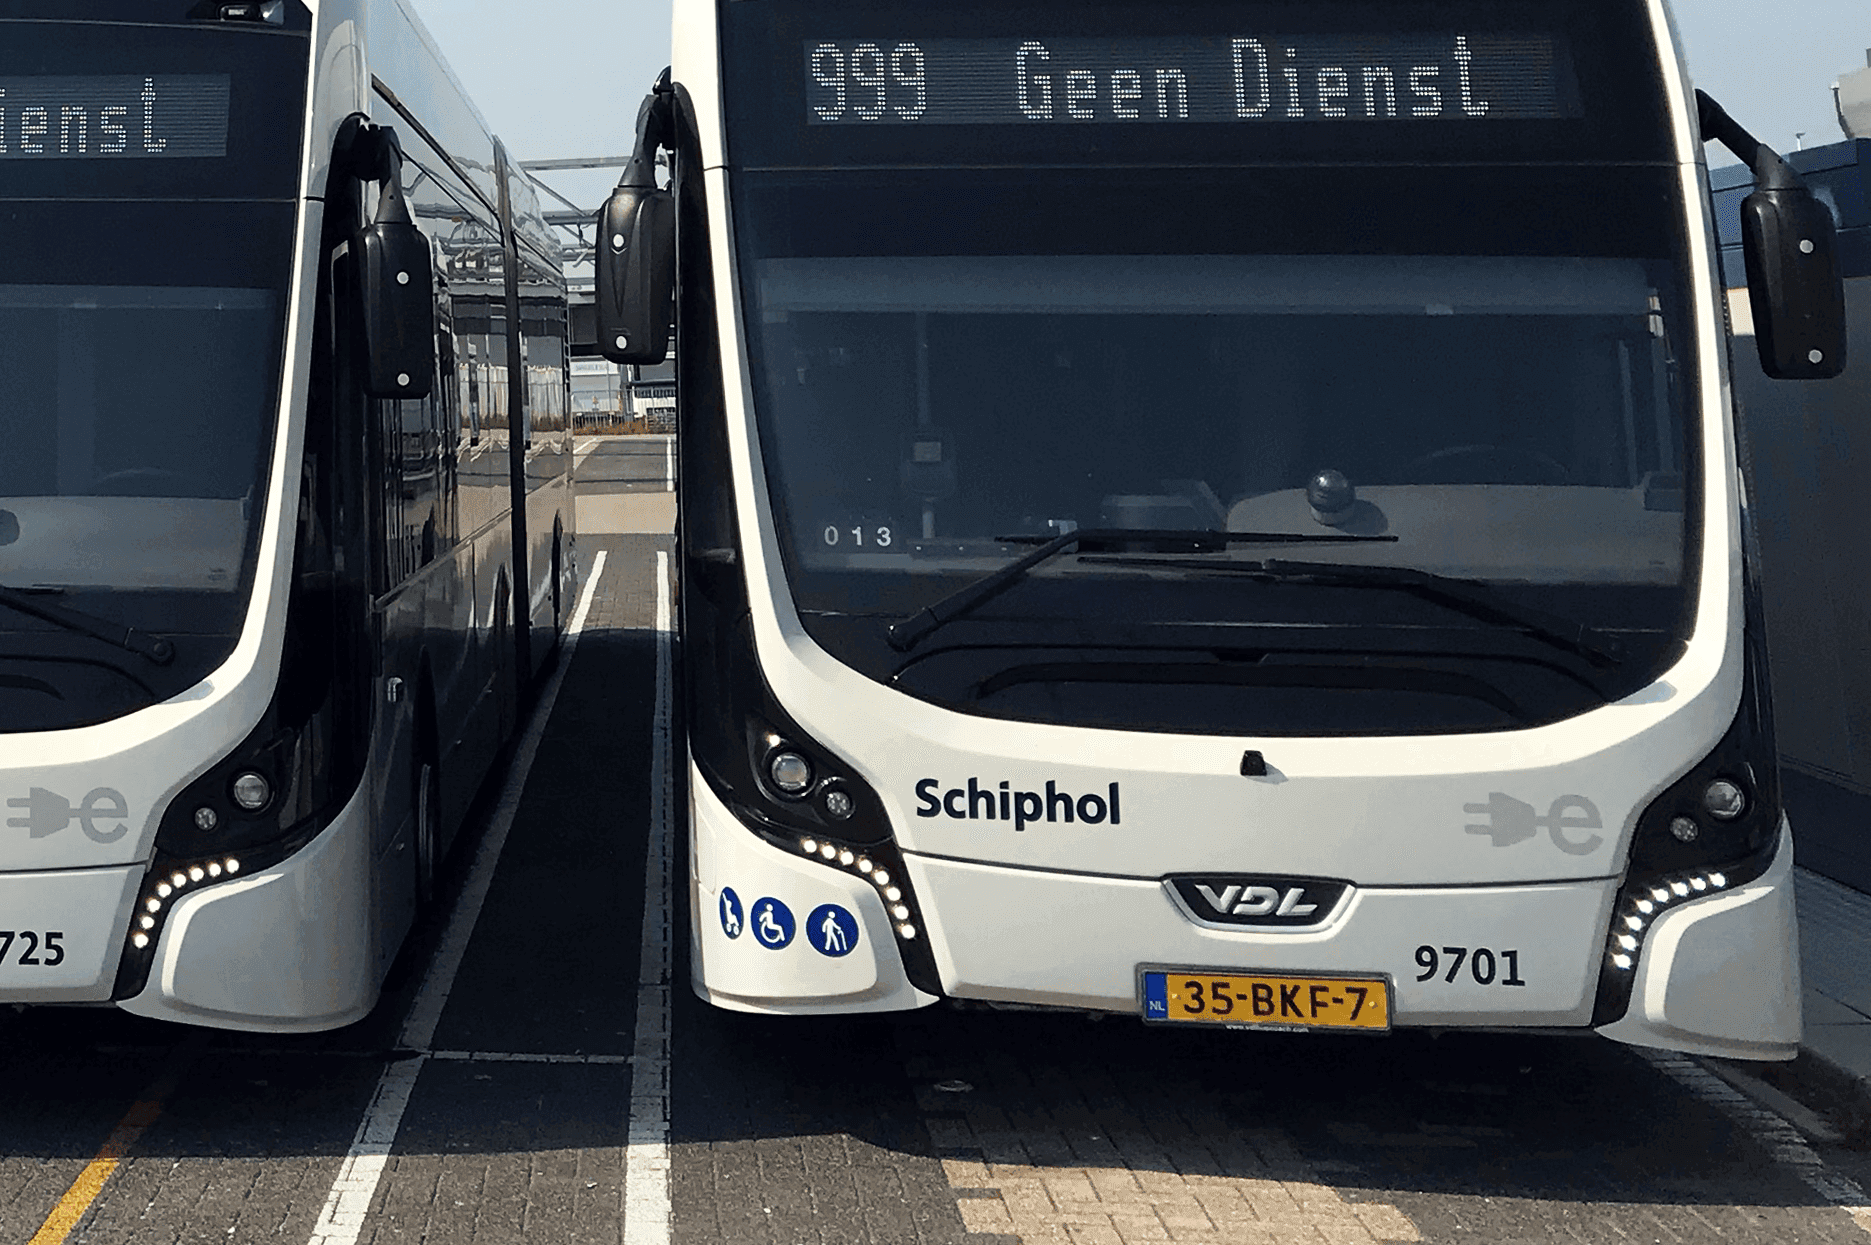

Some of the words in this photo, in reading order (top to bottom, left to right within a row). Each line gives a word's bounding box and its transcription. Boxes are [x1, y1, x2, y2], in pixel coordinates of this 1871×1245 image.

[811, 42, 928, 122] 999
[1015, 40, 1190, 121] Geen
[1231, 35, 1490, 119] Dienst
[915, 776, 1121, 832] Schiphol
[1196, 884, 1320, 917] VDL
[1414, 945, 1526, 987] 9701
[1149, 1000, 1166, 1012] NL
[1183, 980, 1369, 1021] 35-BKF-7
